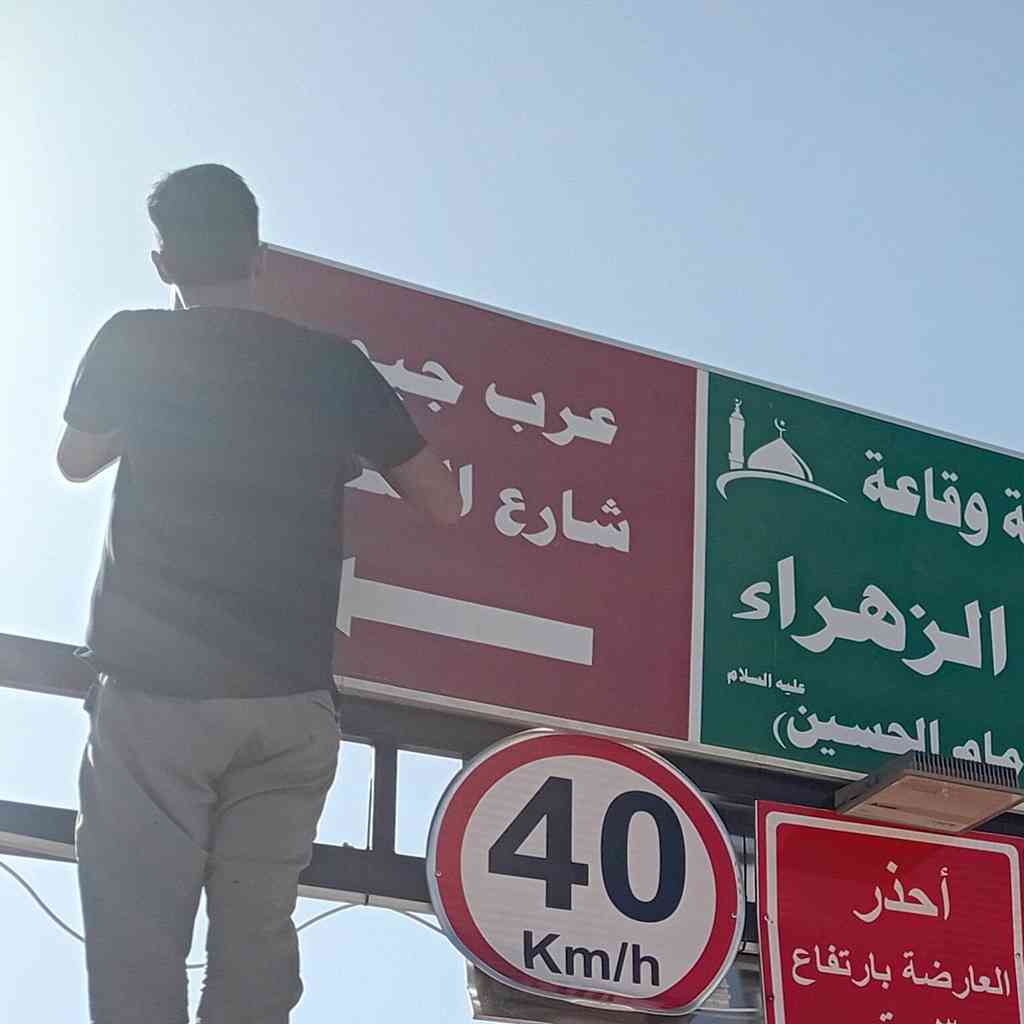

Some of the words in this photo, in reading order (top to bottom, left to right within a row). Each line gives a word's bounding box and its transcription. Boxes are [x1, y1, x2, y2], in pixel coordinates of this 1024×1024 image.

[485, 382, 618, 445] عرب
[494, 487, 630, 553] شارع
[862, 450, 989, 547] وقاعة
[732, 555, 1006, 677] الزهراء
[727, 666, 772, 688] السلام
[776, 678, 806, 696] عليه
[488, 776, 686, 923] 40
[853, 861, 950, 922] أحذر
[522, 930, 660, 987] Km/h
[792, 944, 892, 989] بارتفاع
[902, 951, 1010, 999] العارضة
